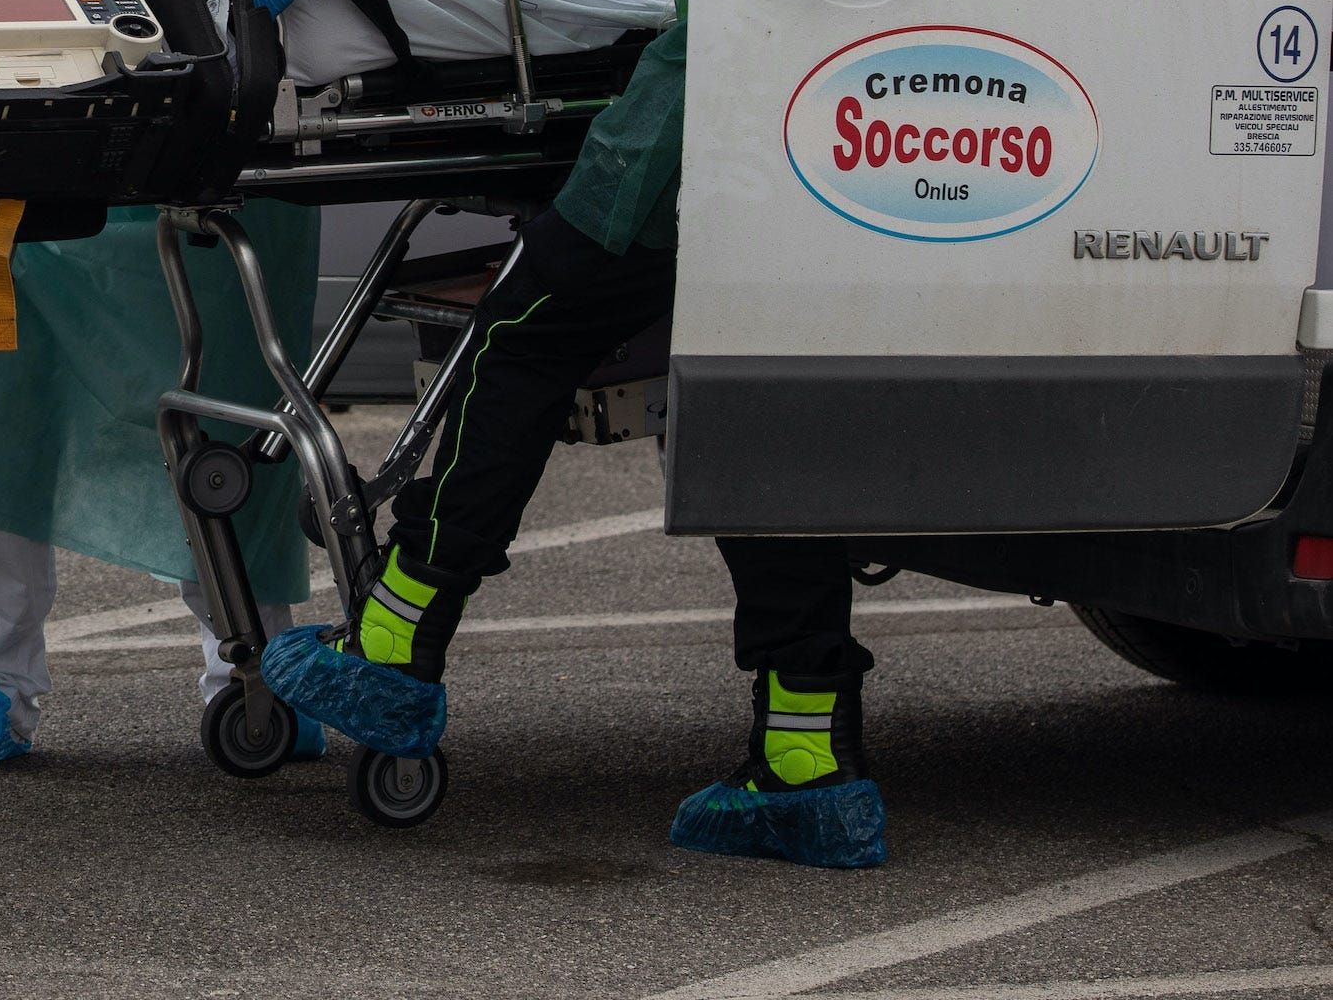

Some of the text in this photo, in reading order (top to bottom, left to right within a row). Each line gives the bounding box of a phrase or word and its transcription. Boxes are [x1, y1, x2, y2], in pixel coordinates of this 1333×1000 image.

[1270, 24, 1301, 65] 14
[865, 72, 1027, 103] Cremona
[1215, 89, 1315, 102] P.M. MULTISERVICE
[436, 103, 486, 117] FERNO
[1238, 104, 1298, 112] ALLESTIMENTO
[1220, 113, 1272, 121] RIPARAZIONE
[1266, 123, 1299, 131] SPECIALI
[832, 96, 1052, 177] Soccorso
[1233, 142, 1293, 153] 335.7466057
[914, 178, 969, 200] Onlus
[1073, 229, 1270, 261] RENAULT
